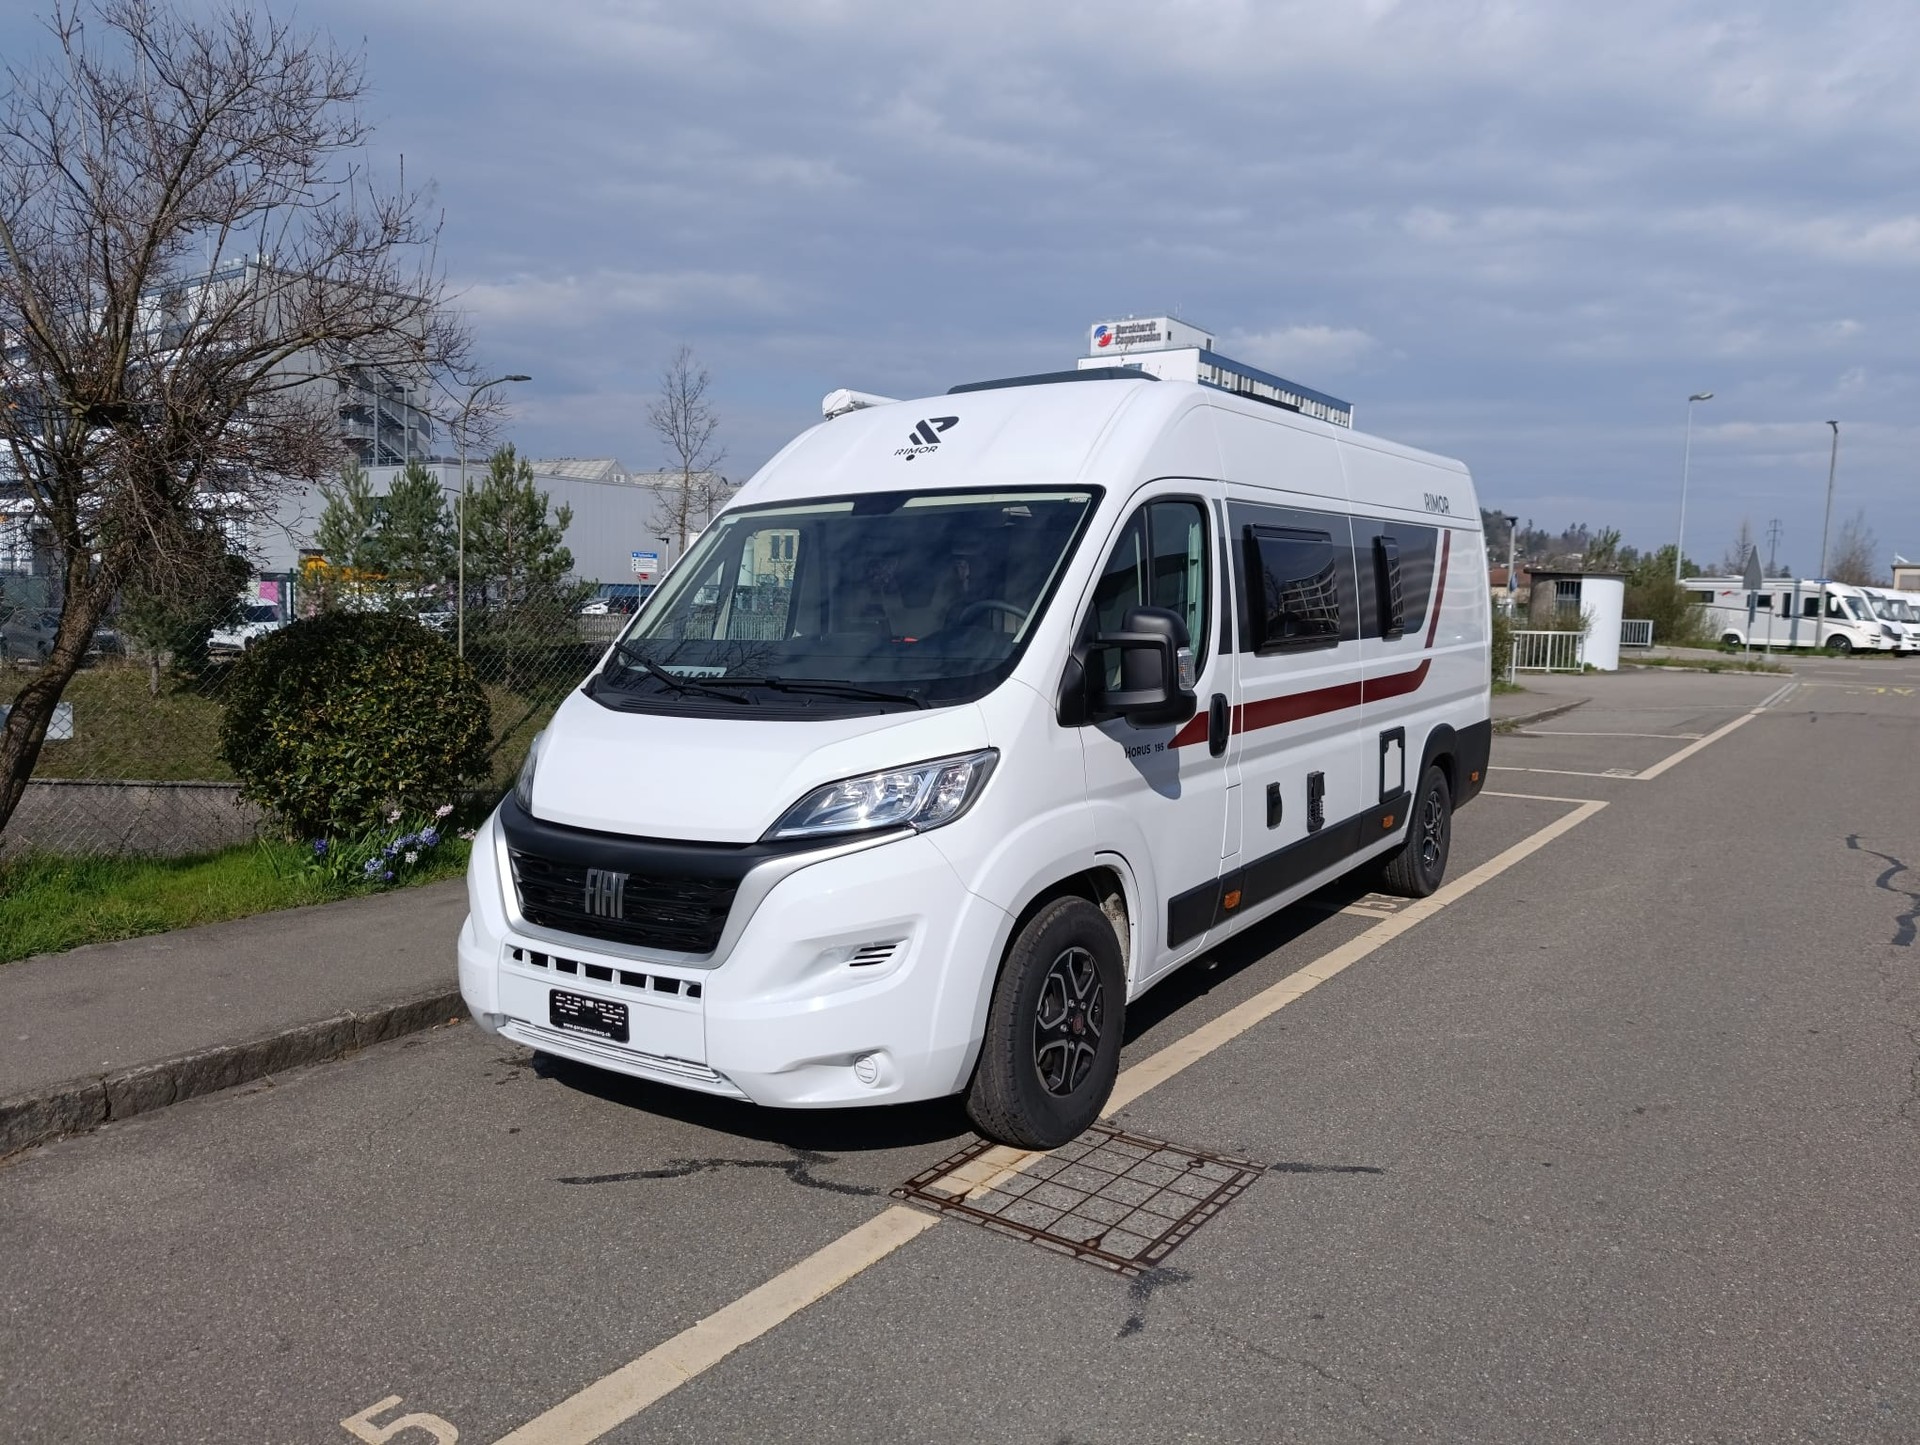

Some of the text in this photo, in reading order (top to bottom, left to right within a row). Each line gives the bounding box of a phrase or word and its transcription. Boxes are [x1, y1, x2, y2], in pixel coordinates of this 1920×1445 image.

[894, 445, 938, 456] RIMOR
[1424, 493, 1450, 514] RIMOR
[1125, 744, 1151, 759] HORUS
[585, 868, 629, 919] FIAT
[340, 1394, 459, 1445] 5
